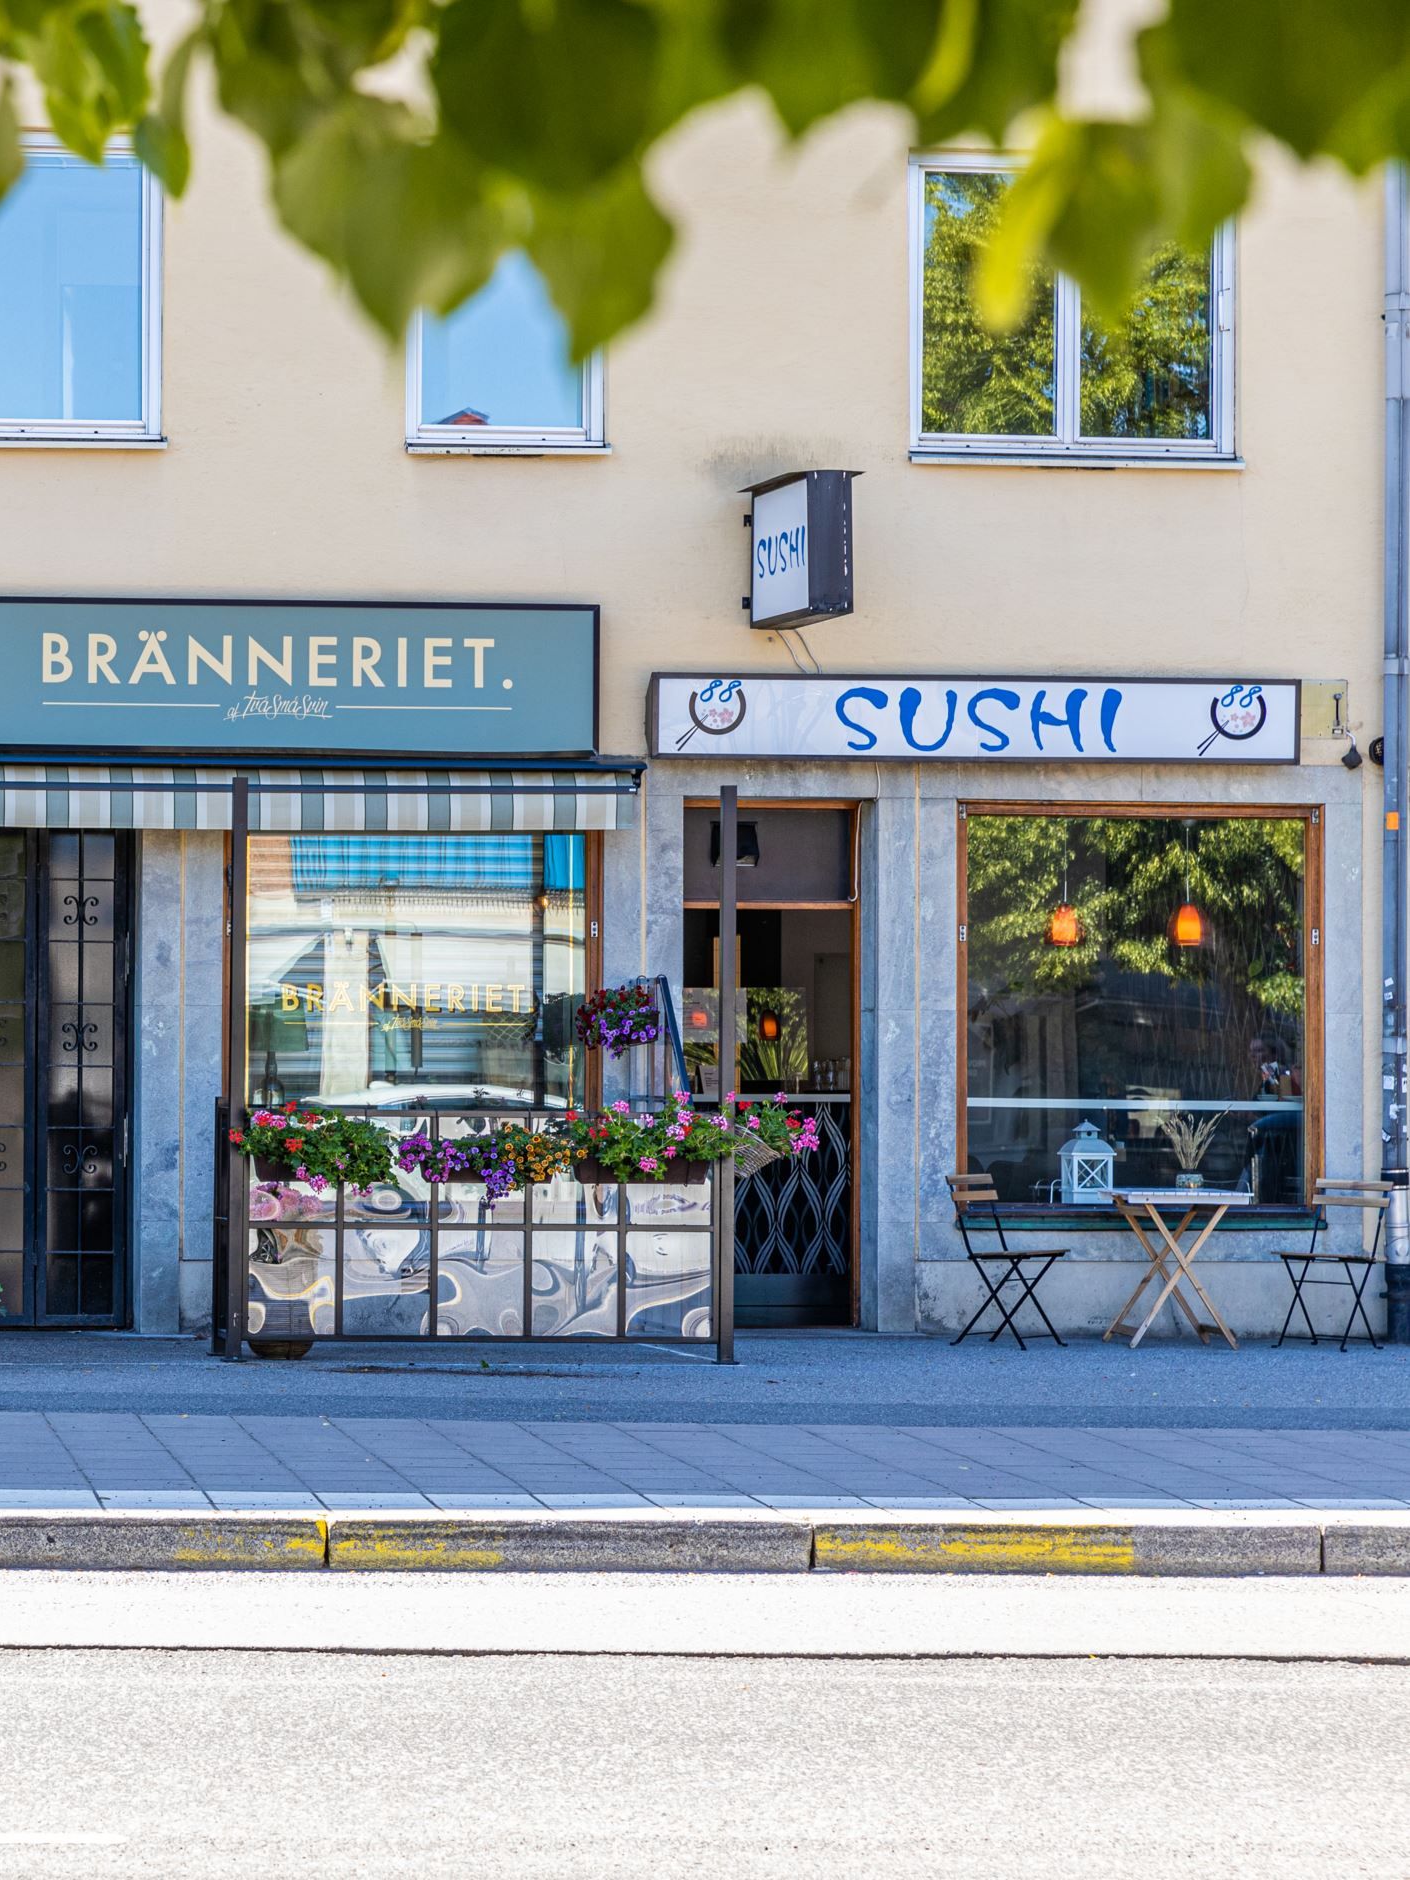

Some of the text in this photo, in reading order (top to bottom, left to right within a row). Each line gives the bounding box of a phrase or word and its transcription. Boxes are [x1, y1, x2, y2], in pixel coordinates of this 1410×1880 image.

[756, 525, 806, 579] SUSHI
[42, 630, 513, 690] BRÄNNERIET.
[835, 686, 1122, 753] SUSHI
[280, 981, 535, 1013] BRÄNNERIET.
